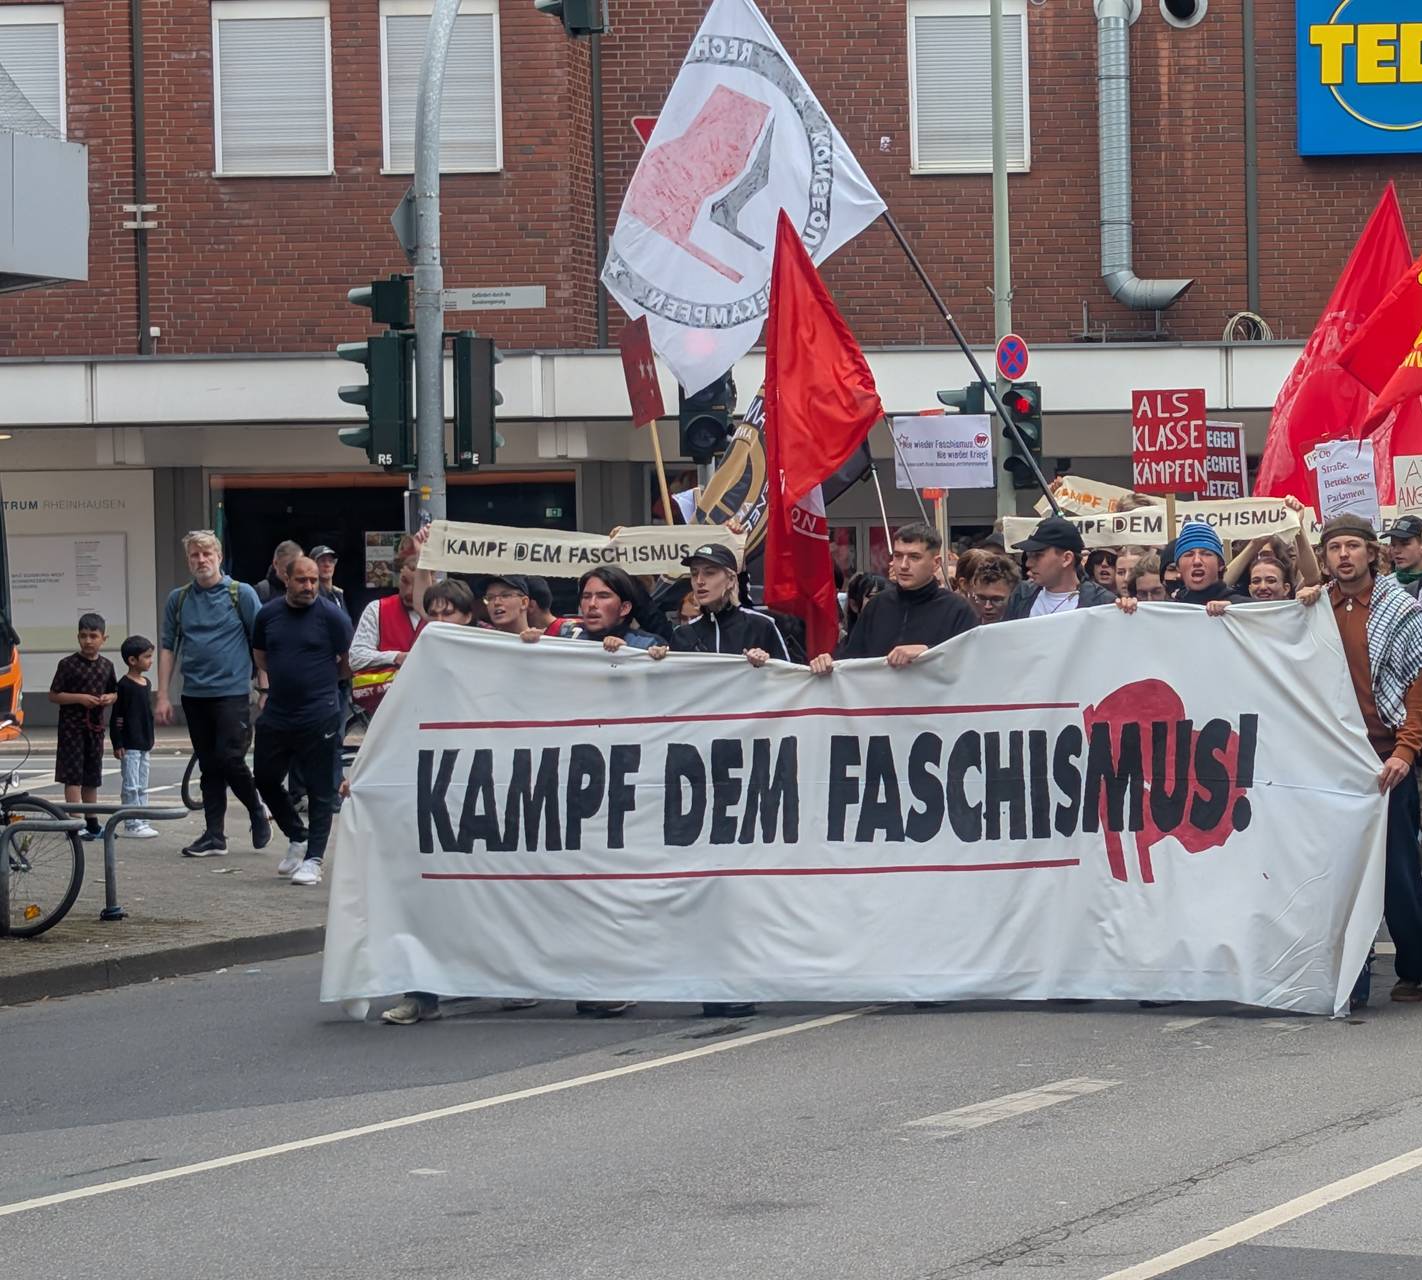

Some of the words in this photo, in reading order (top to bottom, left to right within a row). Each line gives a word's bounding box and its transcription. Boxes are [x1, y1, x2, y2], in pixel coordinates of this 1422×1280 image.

[1136, 393, 1190, 419] ALS
[1132, 420, 1203, 452] KLASSE
[1206, 430, 1236, 449] EGEN
[378, 453, 393, 465] R5
[472, 453, 480, 465] E
[1206, 455, 1241, 474] ECHTE
[1133, 458, 1208, 485] KÄMPFEN
[3, 500, 38, 511] TRUM
[42, 499, 126, 511] RHEINHAUSEN
[1112, 515, 1163, 534] DEM
[446, 538, 508, 559] KAMPF
[514, 541, 562, 564] DEM
[569, 542, 691, 565] FASCHISMUS
[417, 743, 641, 854] KAMPF
[663, 735, 800, 847] DEM
[826, 713, 1259, 843] FASCHISMUS!
